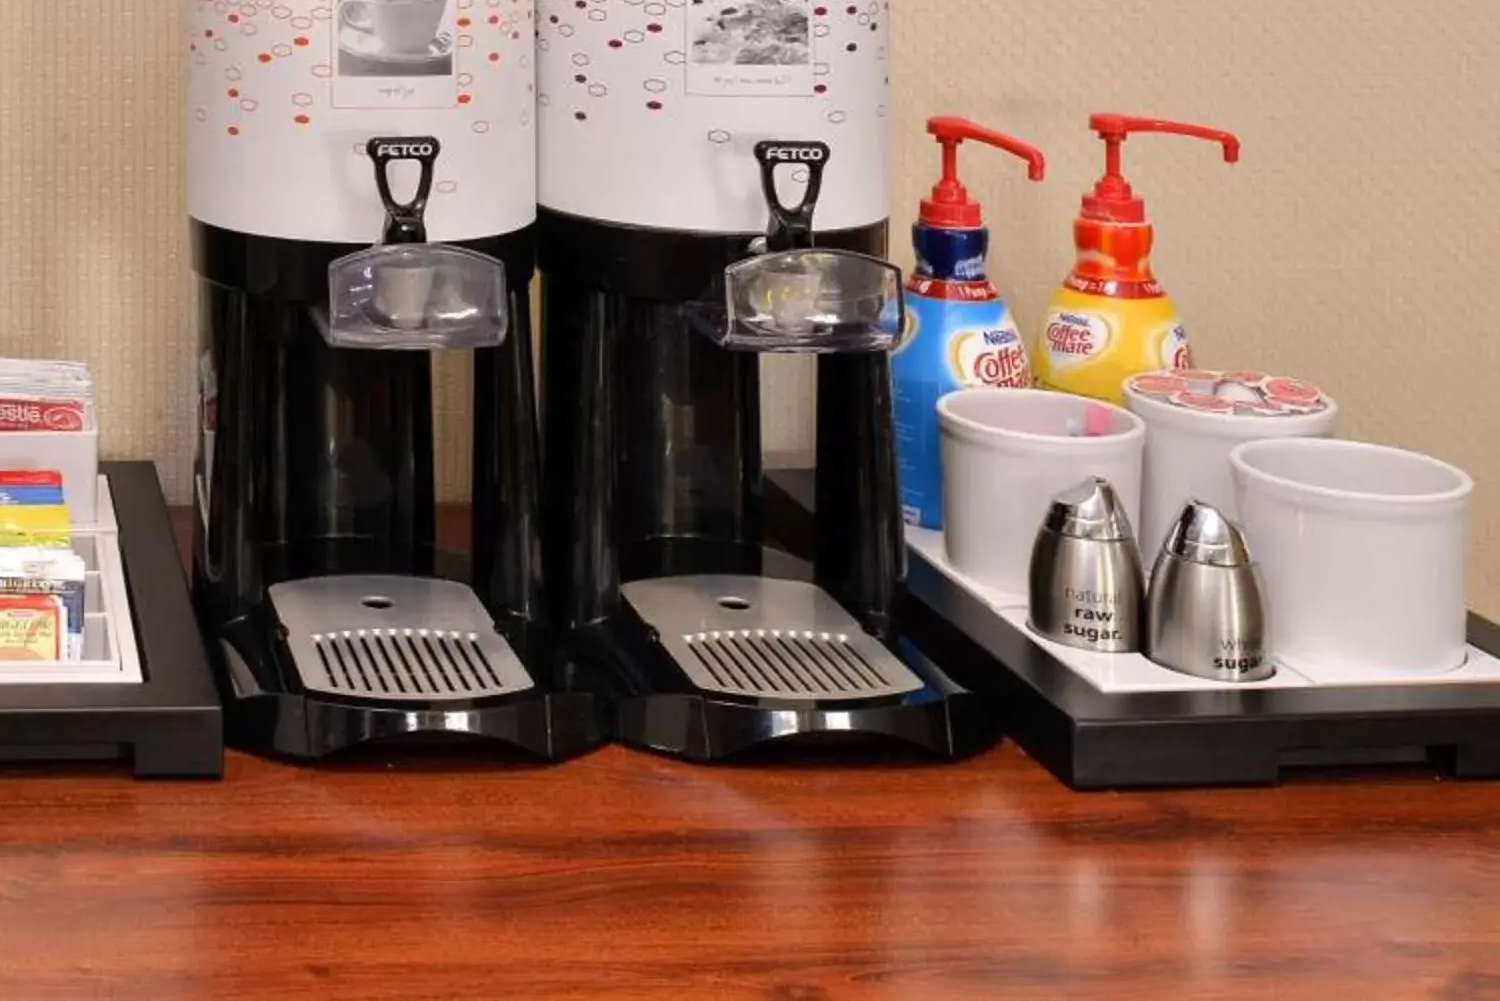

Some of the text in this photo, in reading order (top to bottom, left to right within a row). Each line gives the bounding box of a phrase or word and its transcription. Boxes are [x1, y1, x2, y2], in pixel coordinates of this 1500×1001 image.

[377, 142, 434, 157] FETCO
[765, 146, 823, 160] FETCO
[1075, 606, 1113, 623] raw
